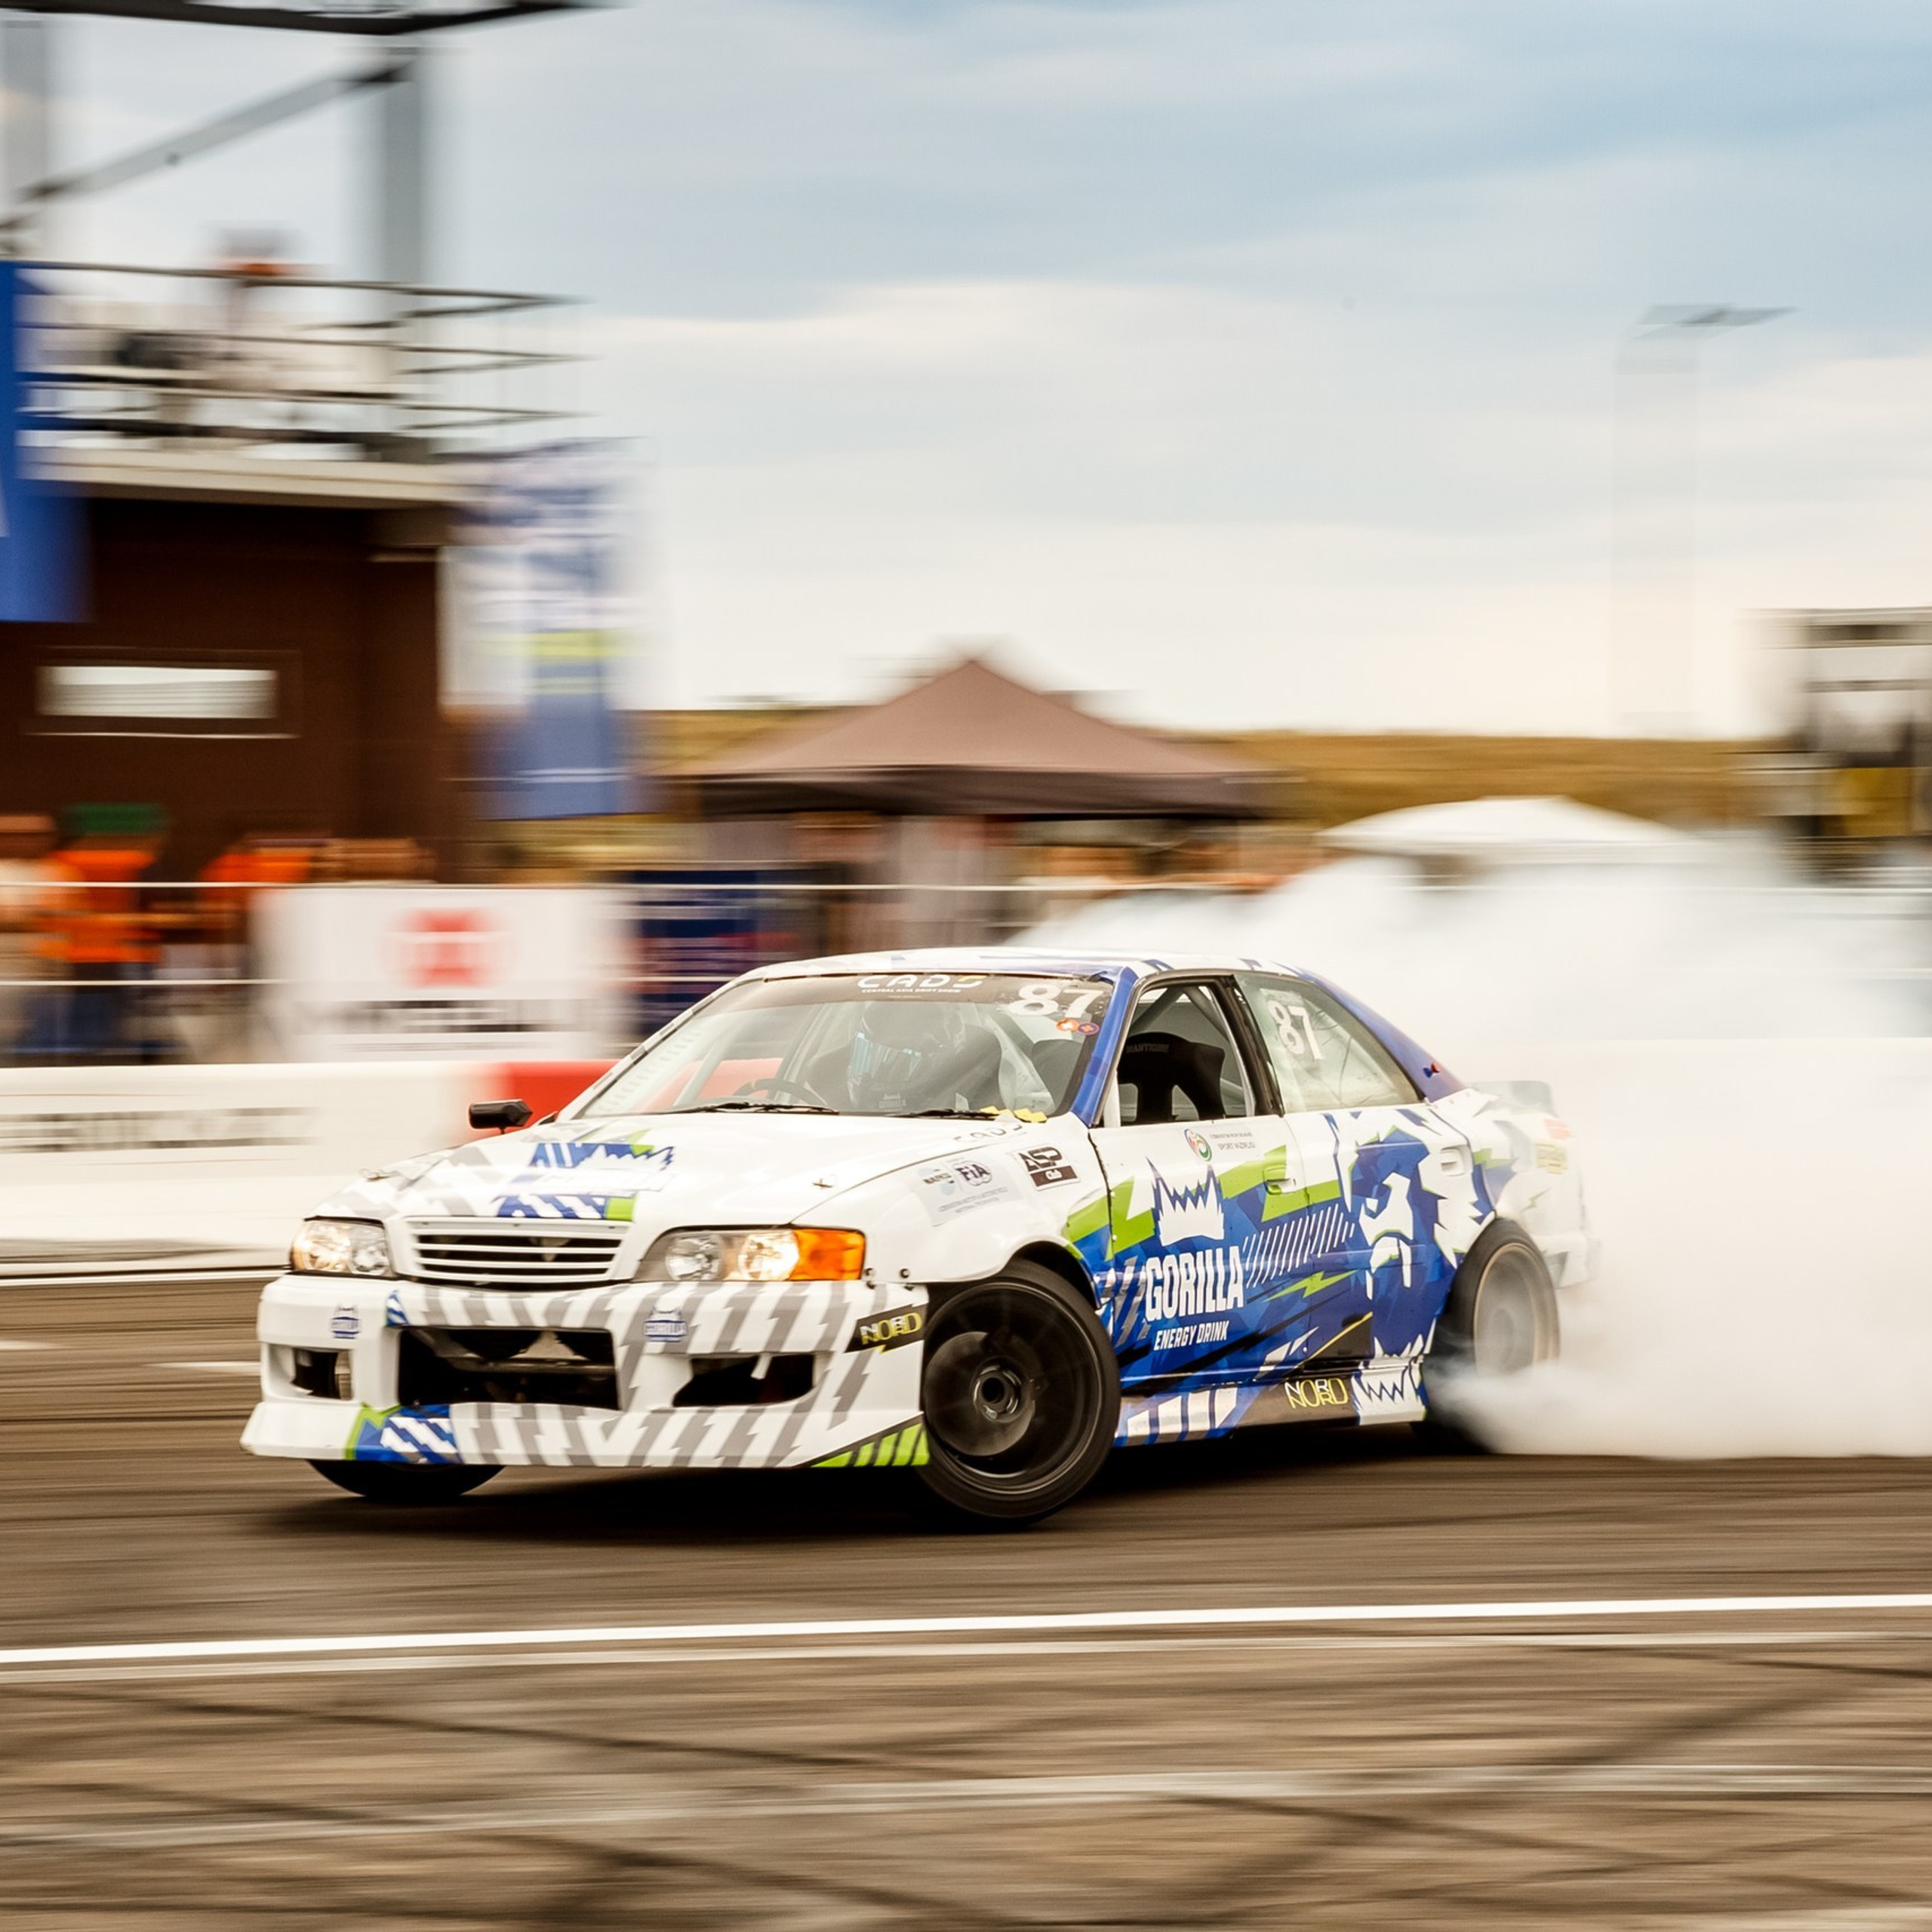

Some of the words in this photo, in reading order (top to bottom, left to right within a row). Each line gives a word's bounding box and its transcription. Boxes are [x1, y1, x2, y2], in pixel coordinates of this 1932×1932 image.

[857, 974, 986, 988] CADS
[1008, 984, 1104, 1018] 87
[1268, 1000, 1323, 1060] 87
[1146, 1245, 1244, 1321] GORILLA
[860, 1312, 922, 1345] NORD
[1153, 1324, 1198, 1351] ENERGY
[1195, 1320, 1229, 1344] DRINK
